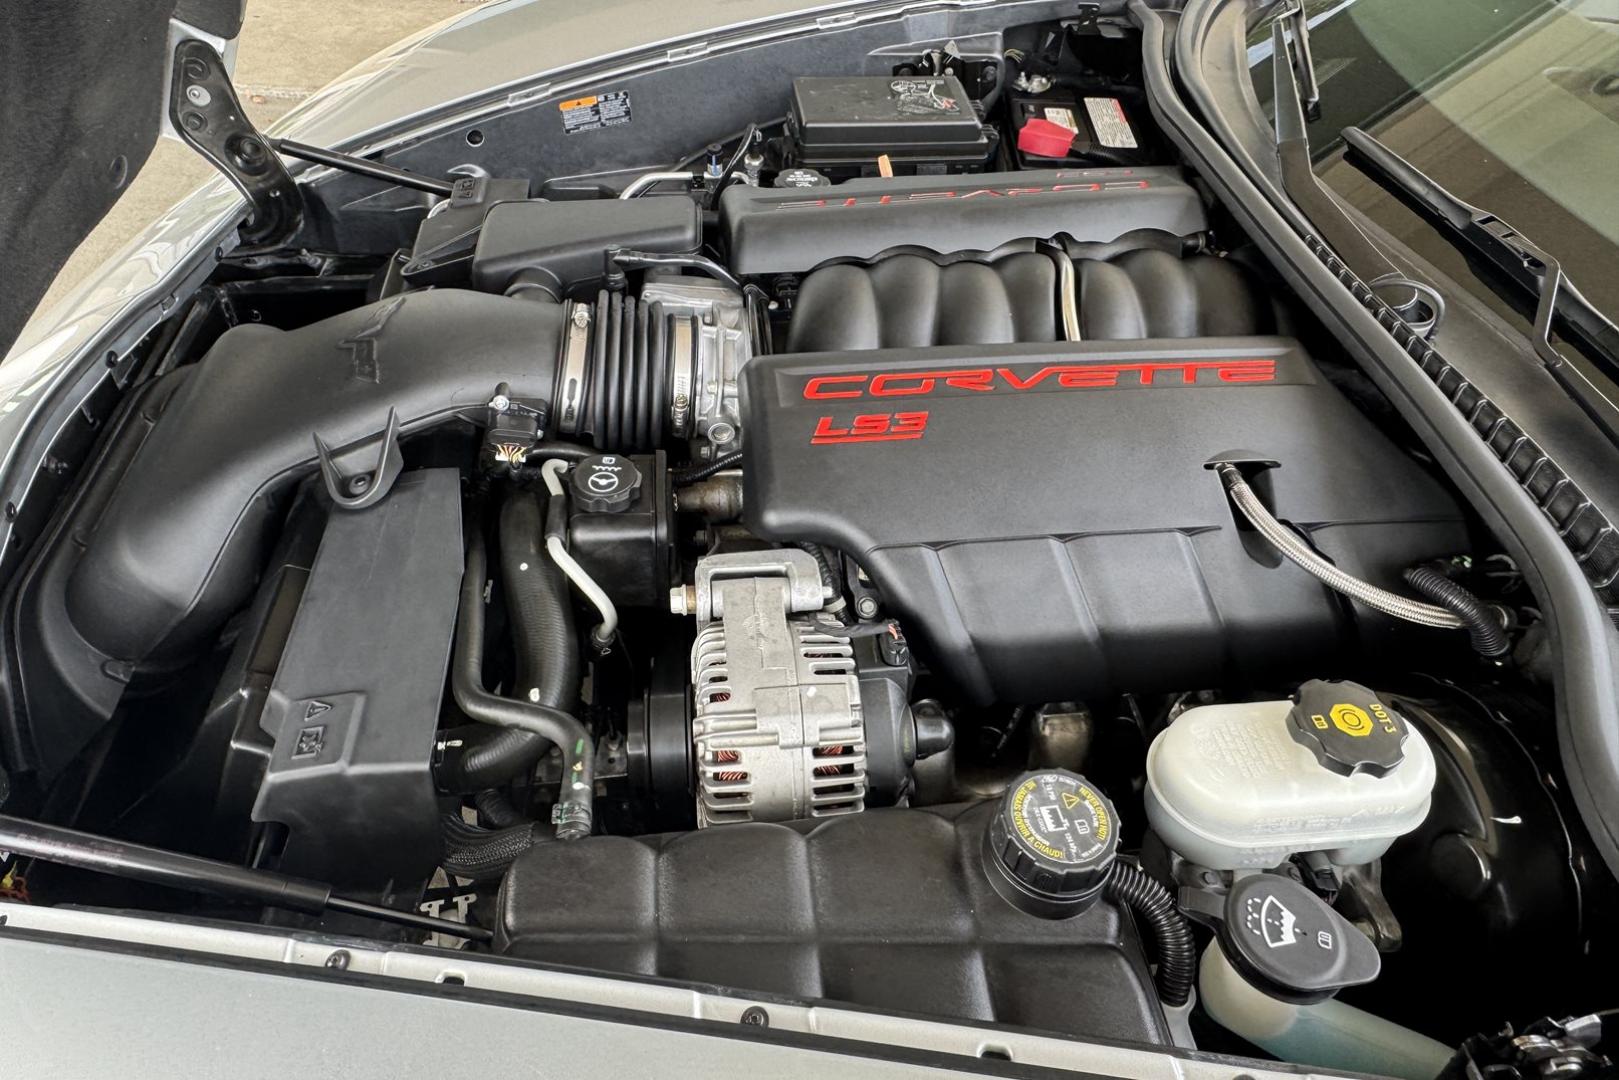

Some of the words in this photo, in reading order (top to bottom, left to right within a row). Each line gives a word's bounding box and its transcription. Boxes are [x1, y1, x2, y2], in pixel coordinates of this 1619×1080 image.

[803, 360, 1276, 400] CORVETTE
[814, 411, 929, 437] LS3
[1369, 704, 1392, 724] DOT
[1384, 725, 1397, 733] 3
[1014, 811, 1031, 838] OUVRIR
[1034, 841, 1064, 859] CHAUD!
